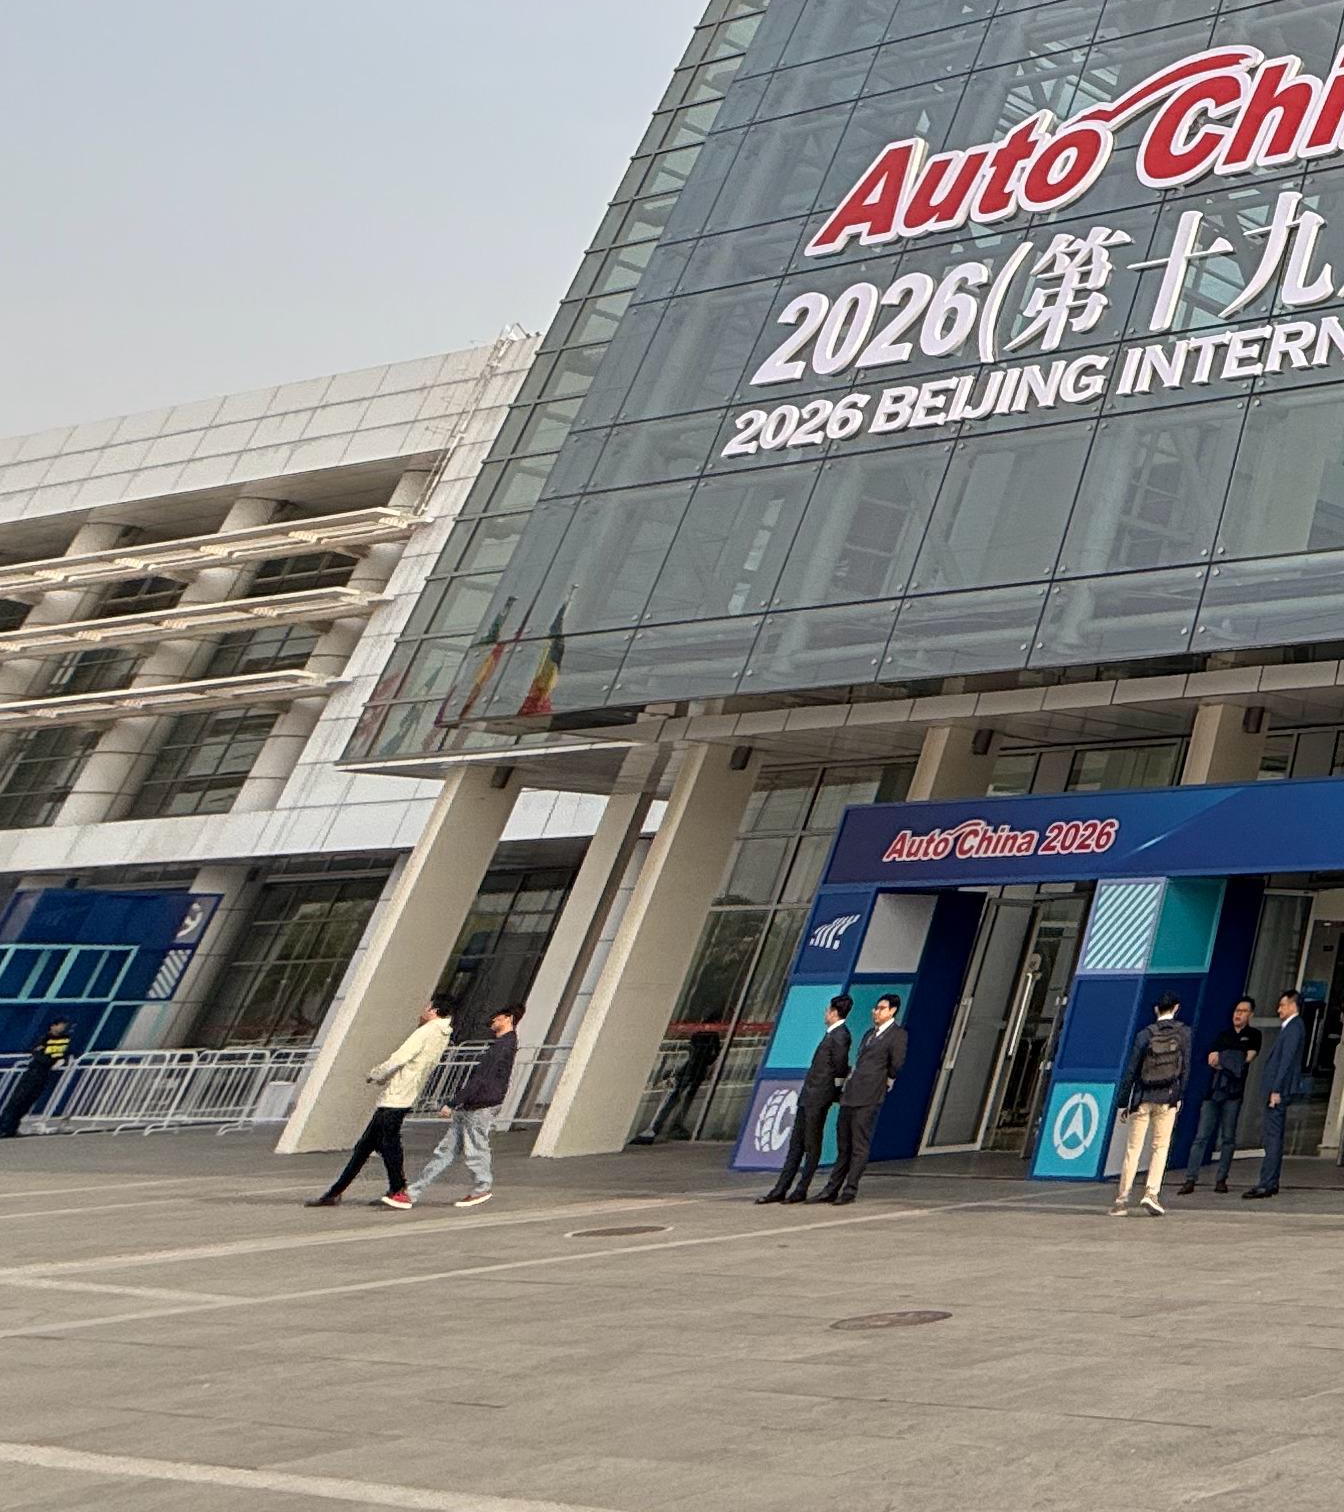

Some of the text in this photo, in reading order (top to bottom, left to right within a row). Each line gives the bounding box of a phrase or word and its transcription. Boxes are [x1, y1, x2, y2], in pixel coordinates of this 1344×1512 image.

[805, 110, 1114, 255] Auto
[722, 393, 870, 456] 2026
[869, 355, 1111, 434] BEIJING
[882, 819, 1119, 862] Auto China 2026
